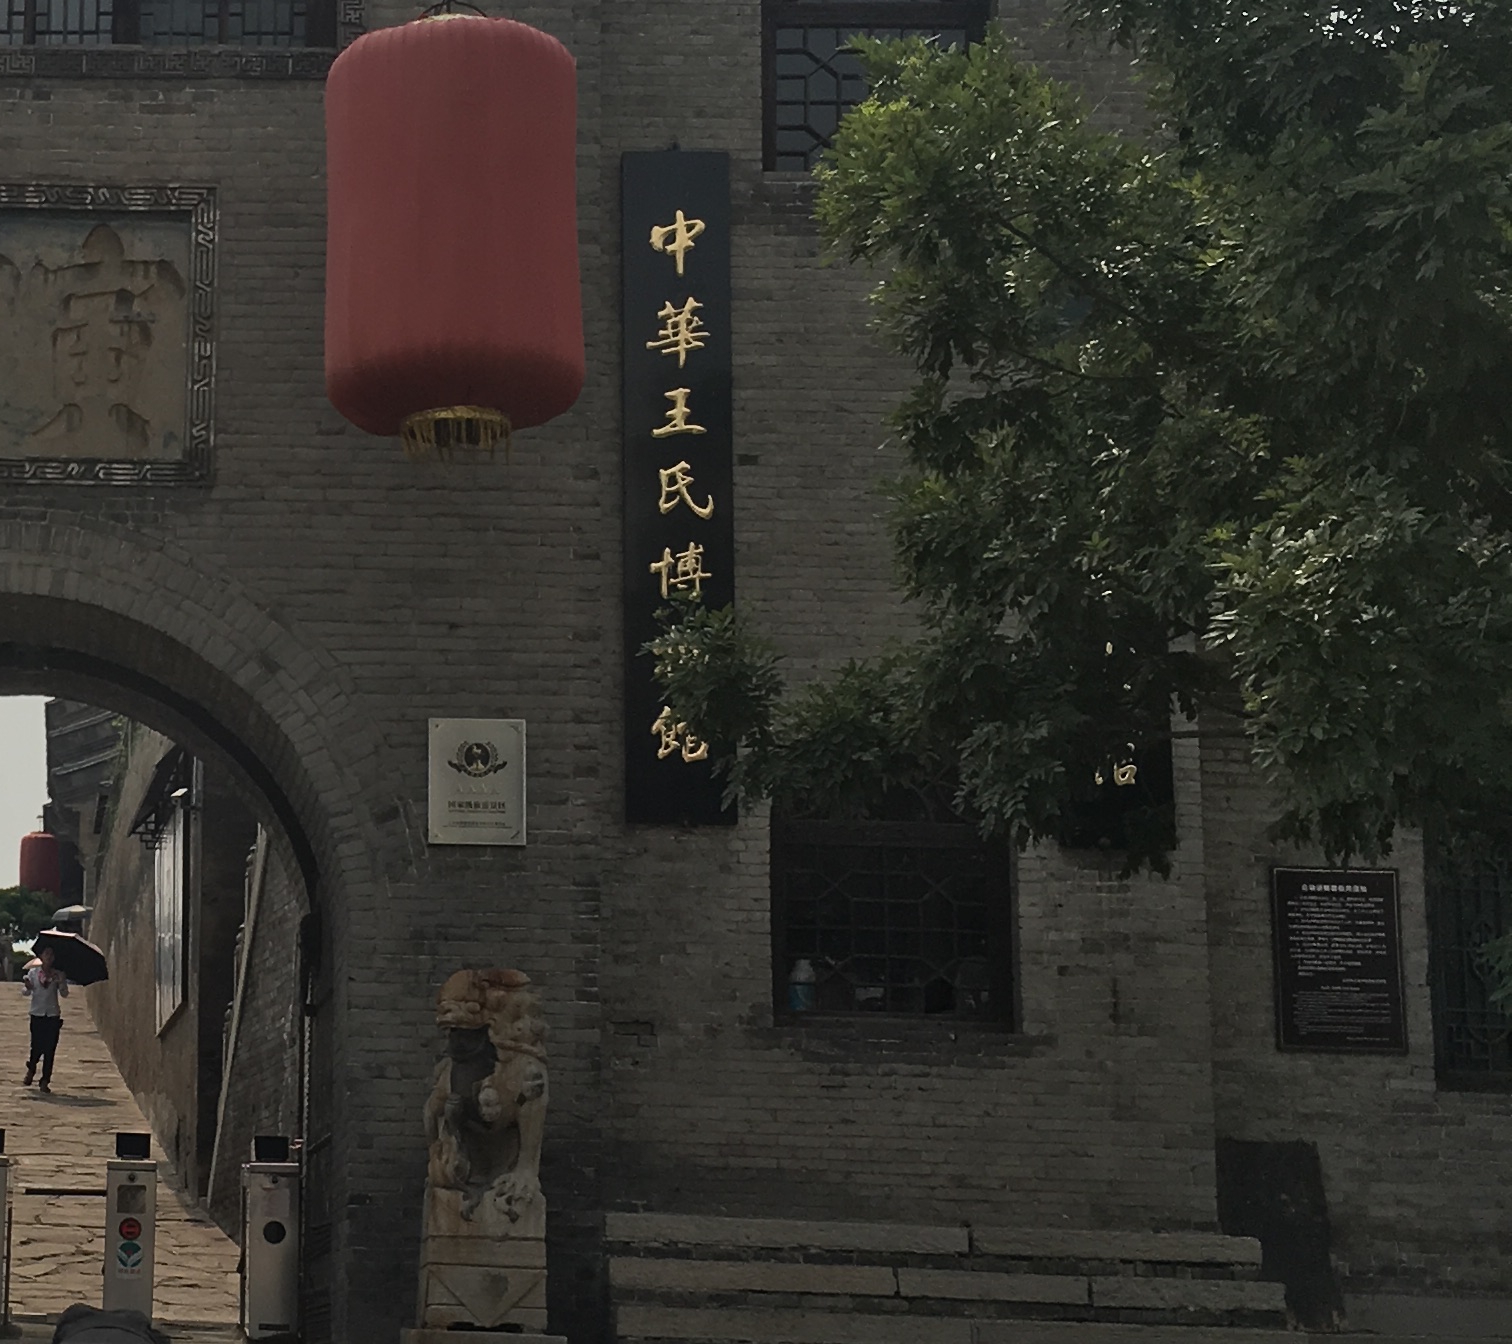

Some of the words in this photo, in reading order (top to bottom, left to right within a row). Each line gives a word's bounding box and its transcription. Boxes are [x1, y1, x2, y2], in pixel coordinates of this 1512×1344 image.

[645, 209, 715, 763] 中華王氏博館
